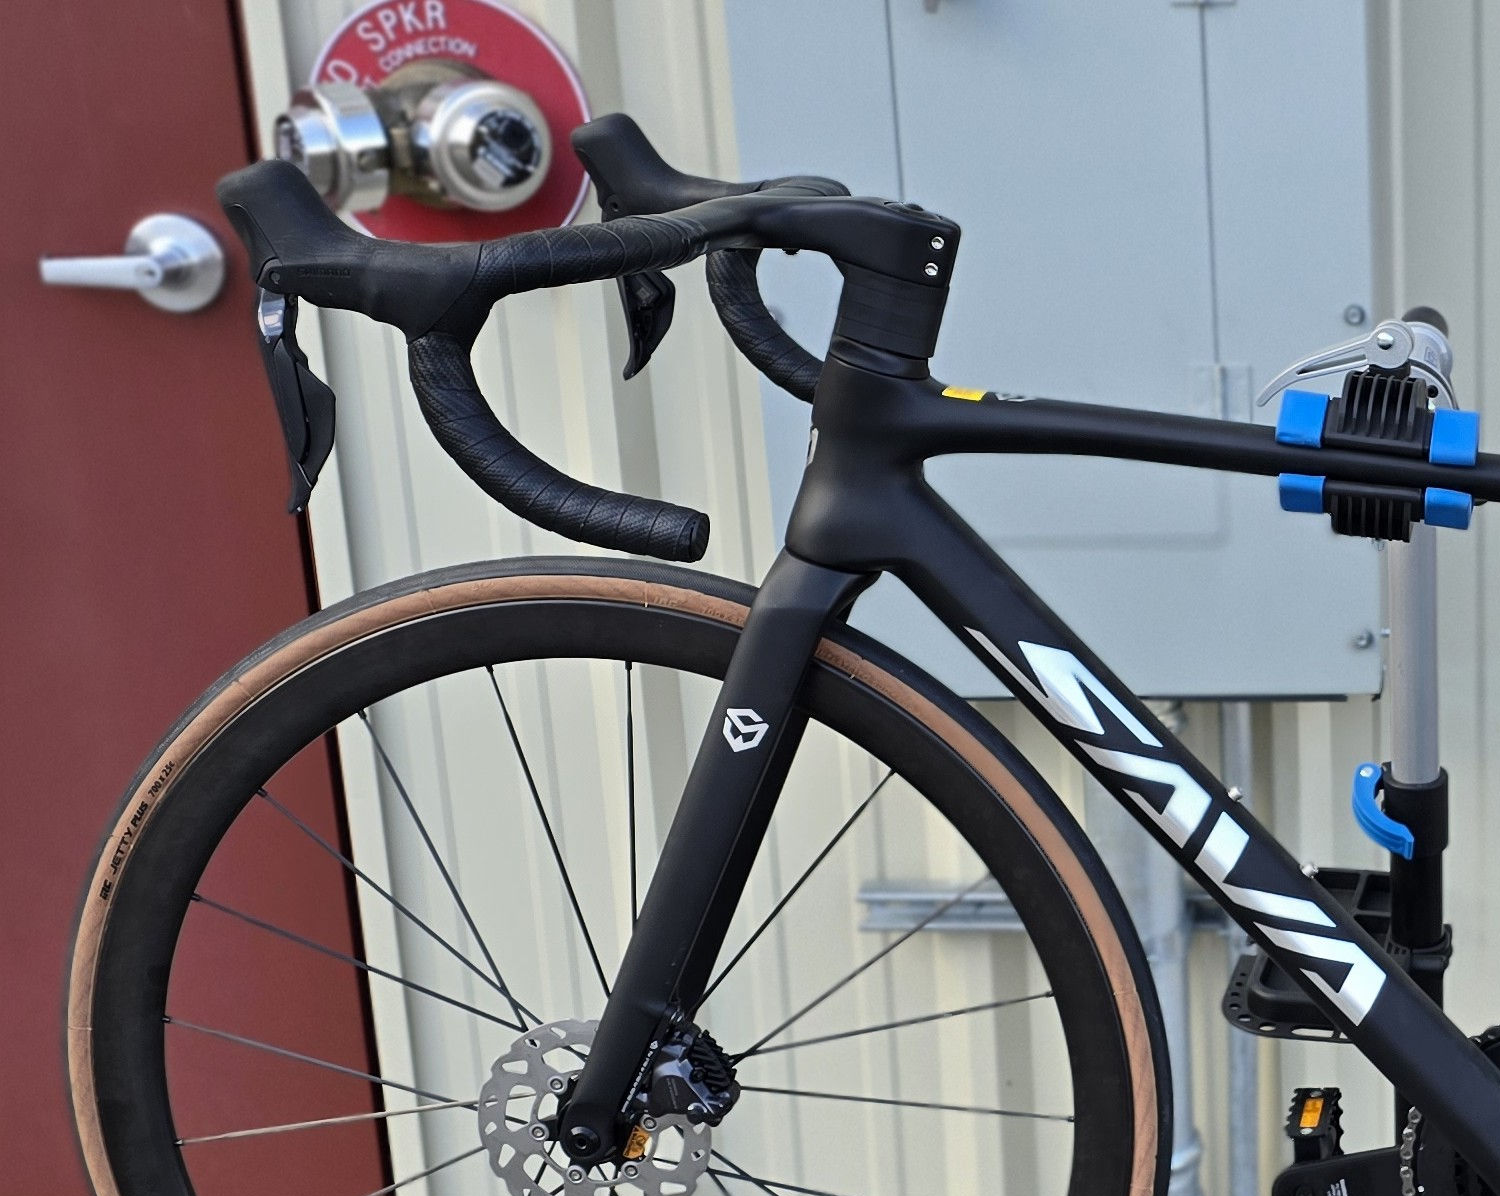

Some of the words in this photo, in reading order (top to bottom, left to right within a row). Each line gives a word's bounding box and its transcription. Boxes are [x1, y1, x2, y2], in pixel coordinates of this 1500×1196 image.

[356, 0, 446, 52] SPKR
[379, 35, 477, 72] CONNECTION
[110, 827, 133, 875] JETTY
[130, 801, 149, 828] PLUS
[148, 780, 162, 797] 700
[964, 627, 1387, 1026] SAVA
